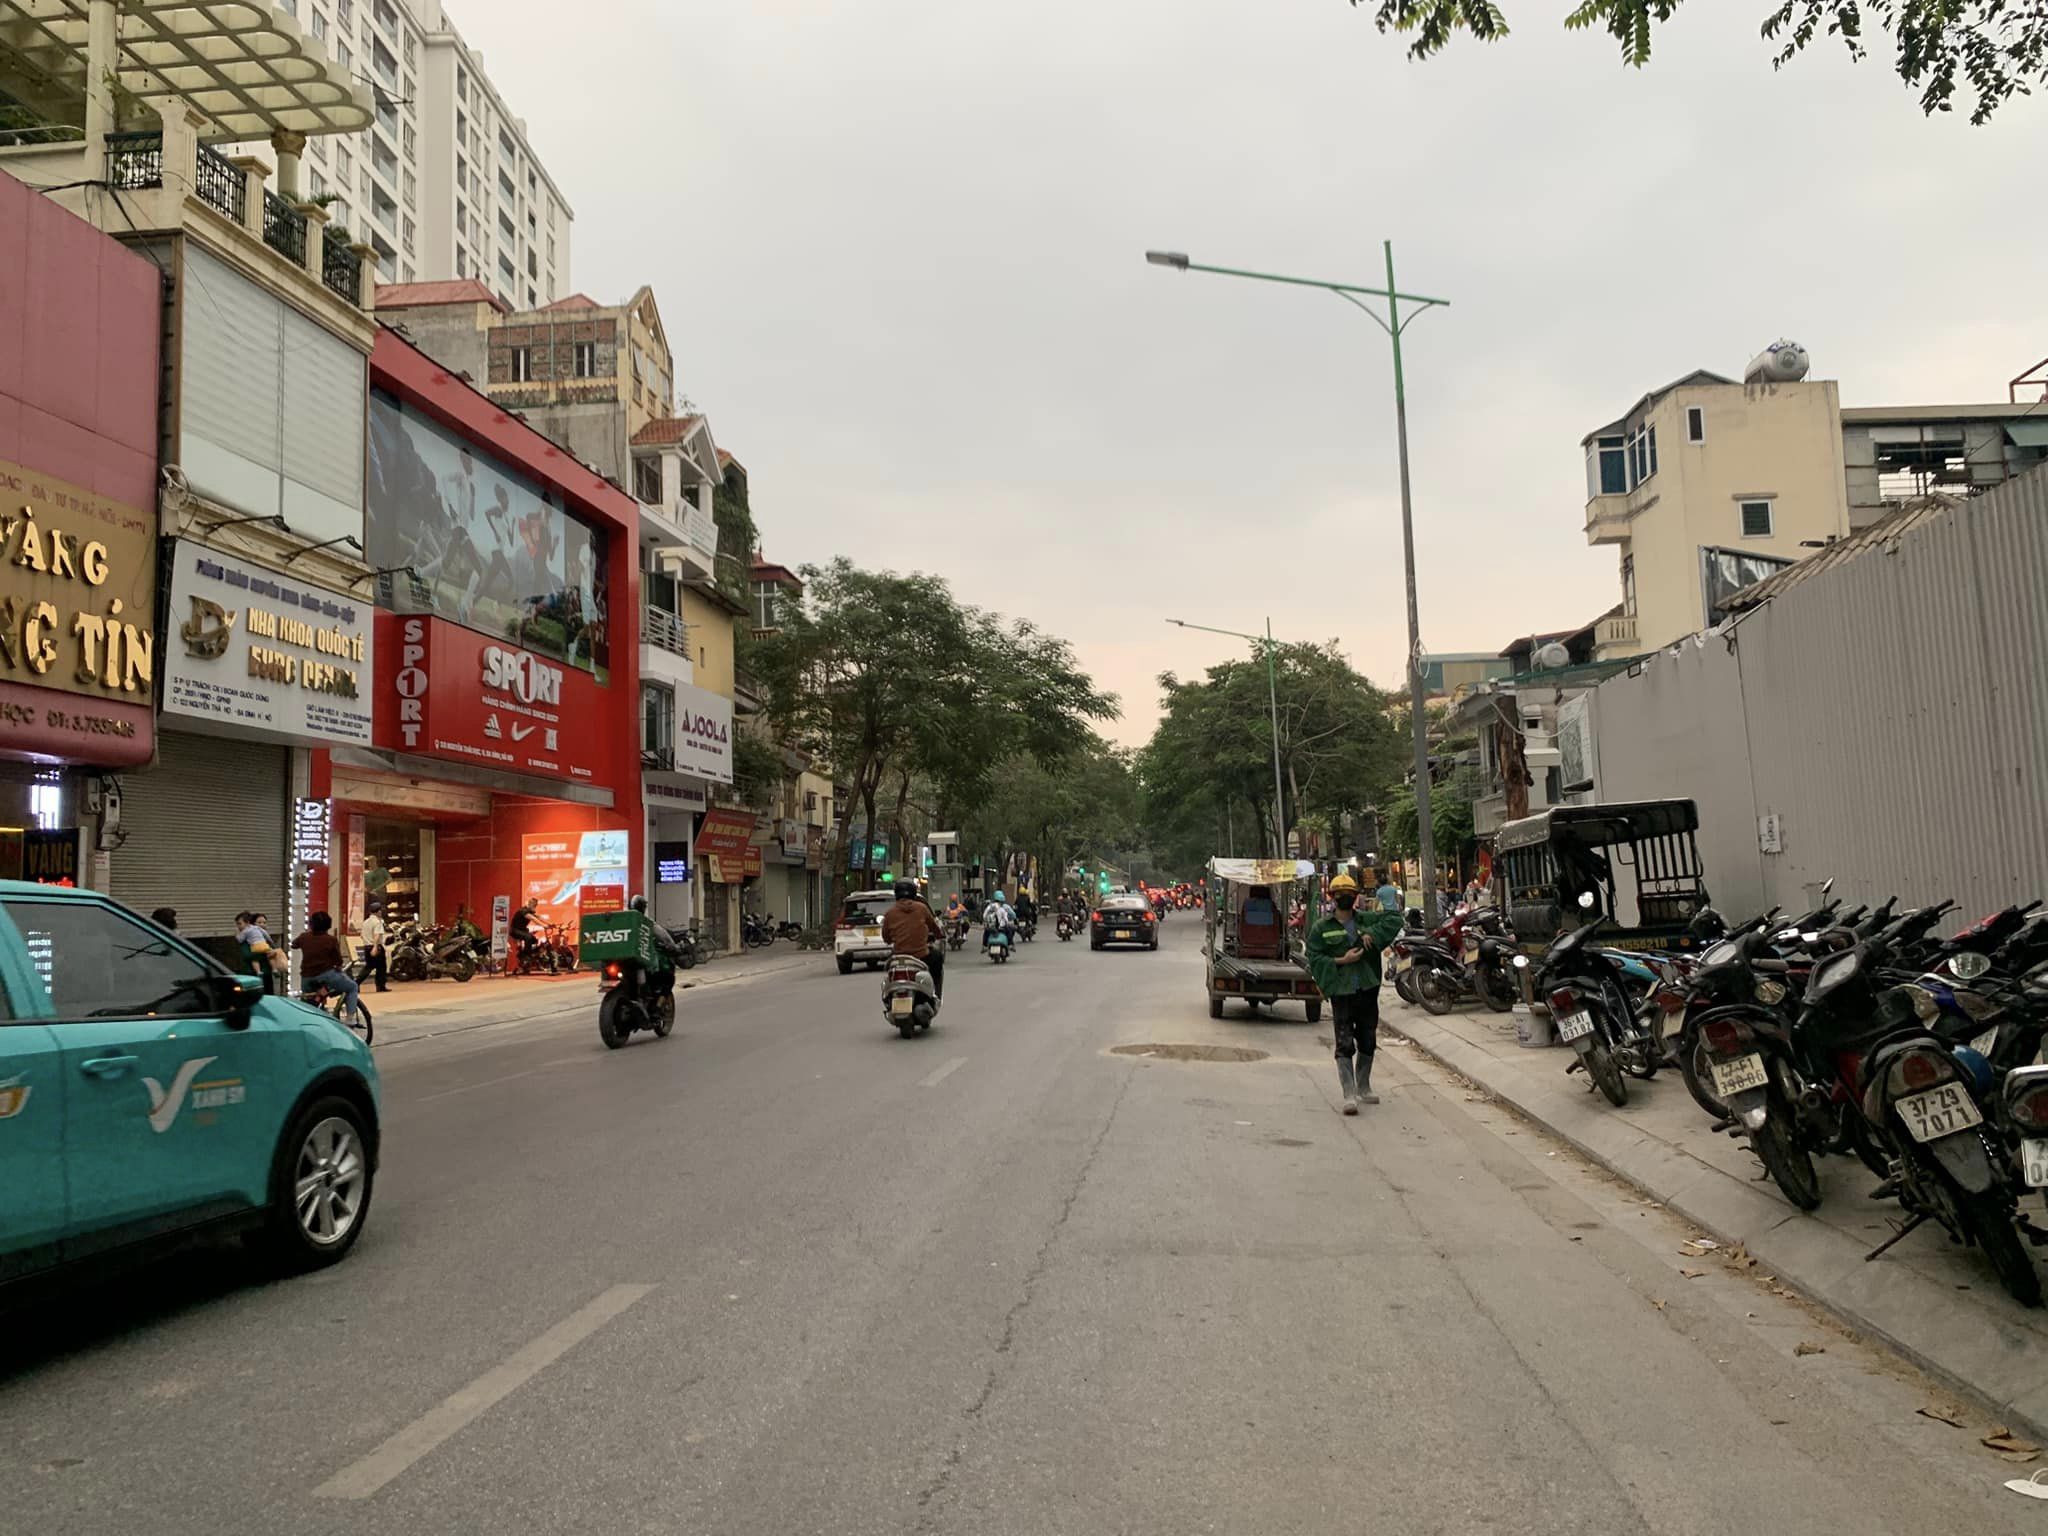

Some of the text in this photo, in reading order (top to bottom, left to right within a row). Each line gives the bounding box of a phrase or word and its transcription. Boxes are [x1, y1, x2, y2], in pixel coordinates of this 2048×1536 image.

[246, 607, 276, 639] NHA
[276, 616, 315, 650] KHOA
[299, 848, 323, 861] 122
[1916, 1106, 1972, 1138] 7071
